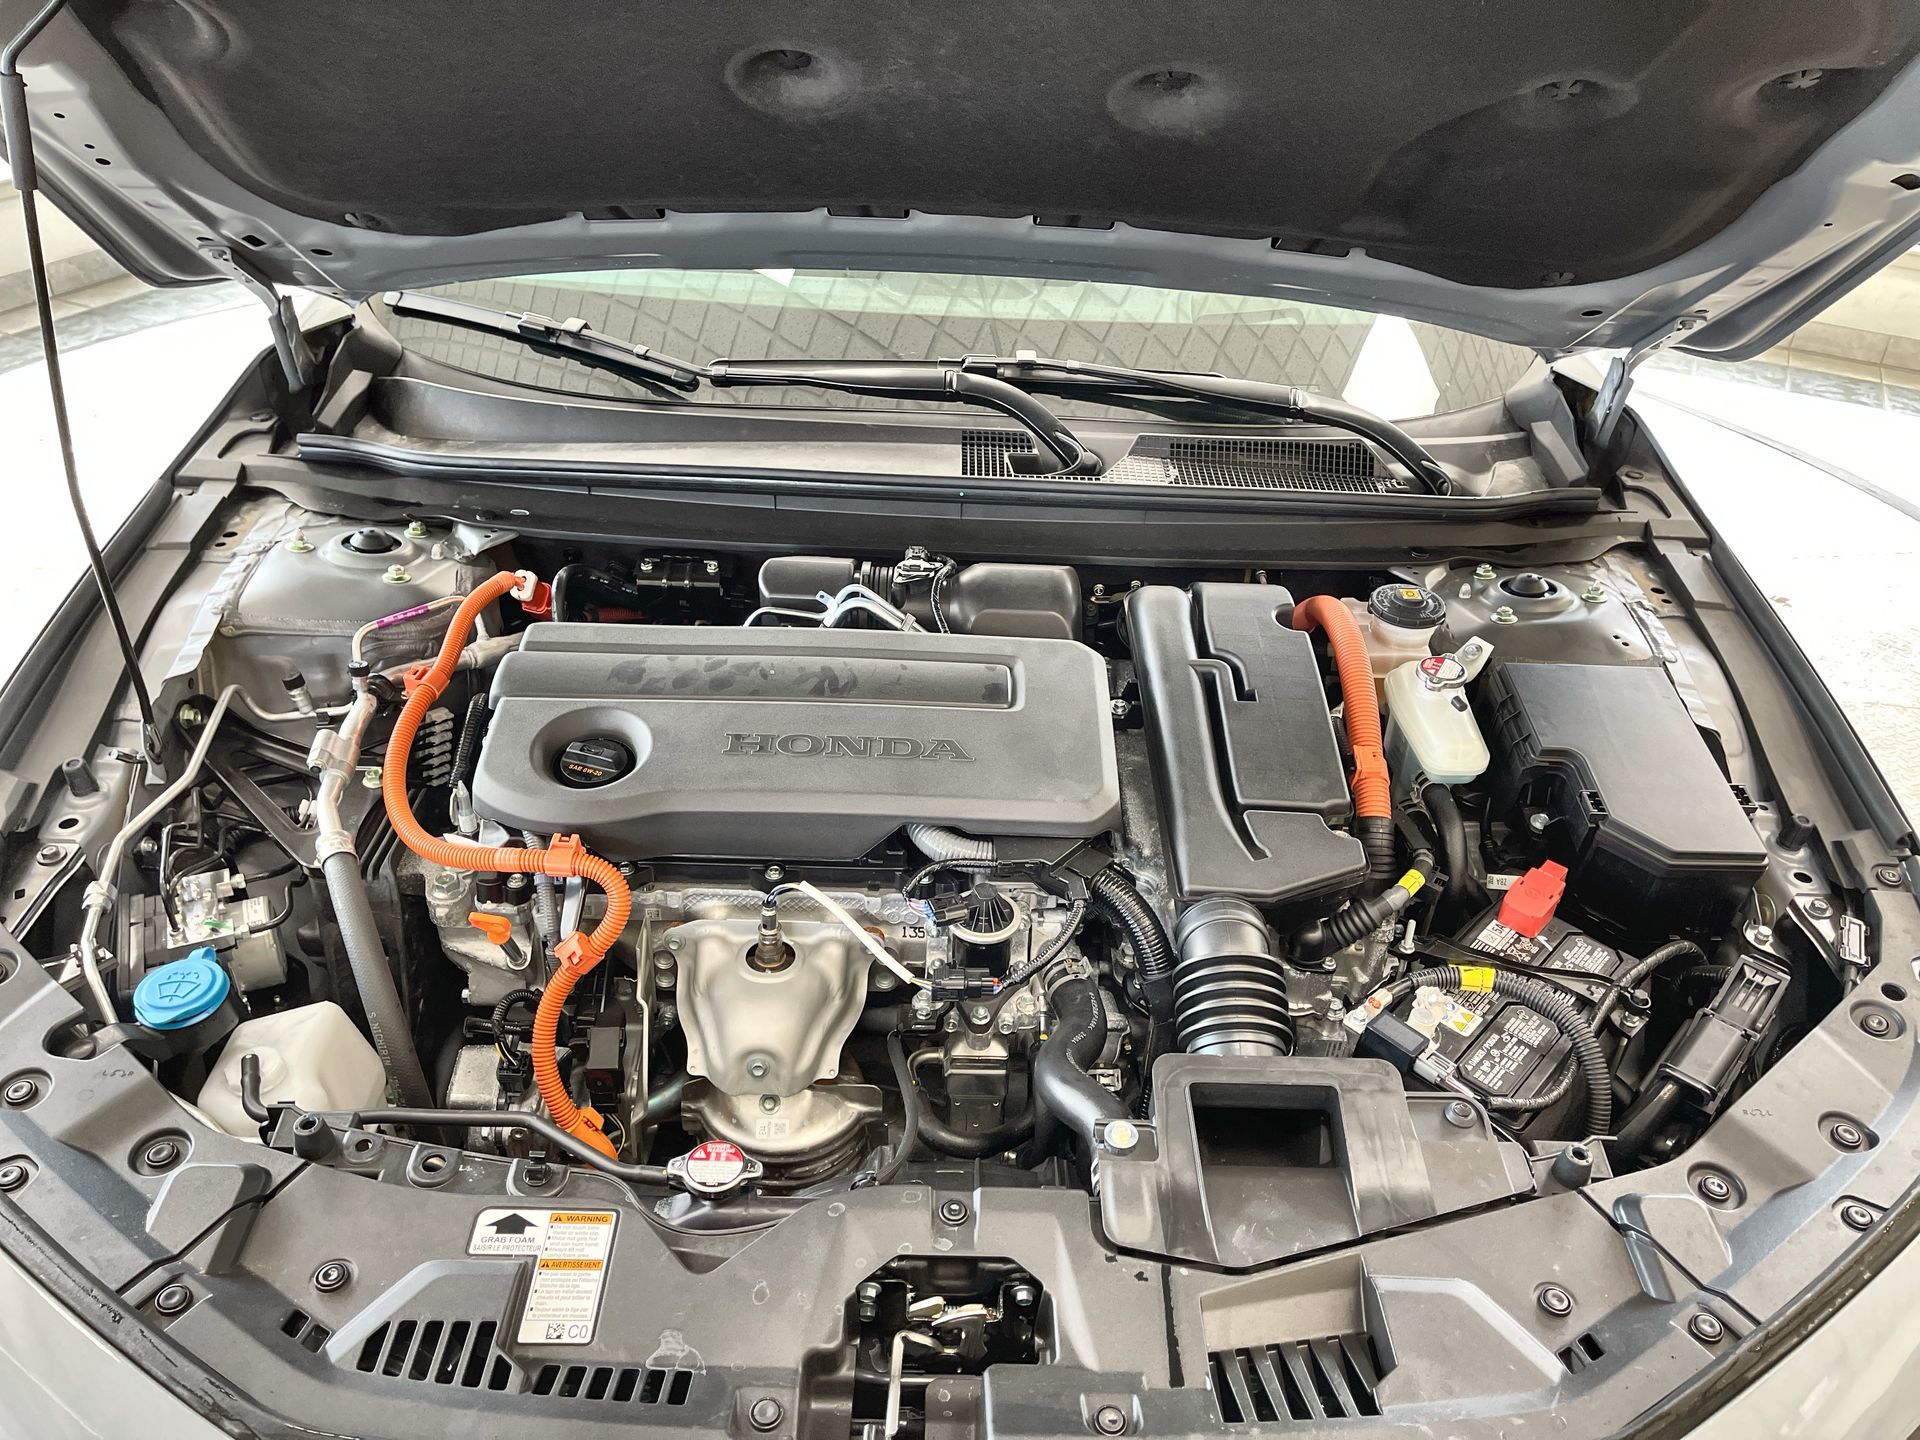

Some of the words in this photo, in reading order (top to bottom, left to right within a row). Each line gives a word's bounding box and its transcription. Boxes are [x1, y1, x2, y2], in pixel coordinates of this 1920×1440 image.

[722, 732, 976, 762] HONDA
[568, 763, 583, 773] SAE
[582, 767, 603, 777] 0W-20
[902, 926, 926, 938] 135
[480, 1236, 507, 1244] GRAB
[508, 1236, 536, 1244] FOAM
[472, 1244, 493, 1252] SAISIR
[493, 1244, 501, 1252] LE
[501, 1244, 542, 1252] PROTECTEUR
